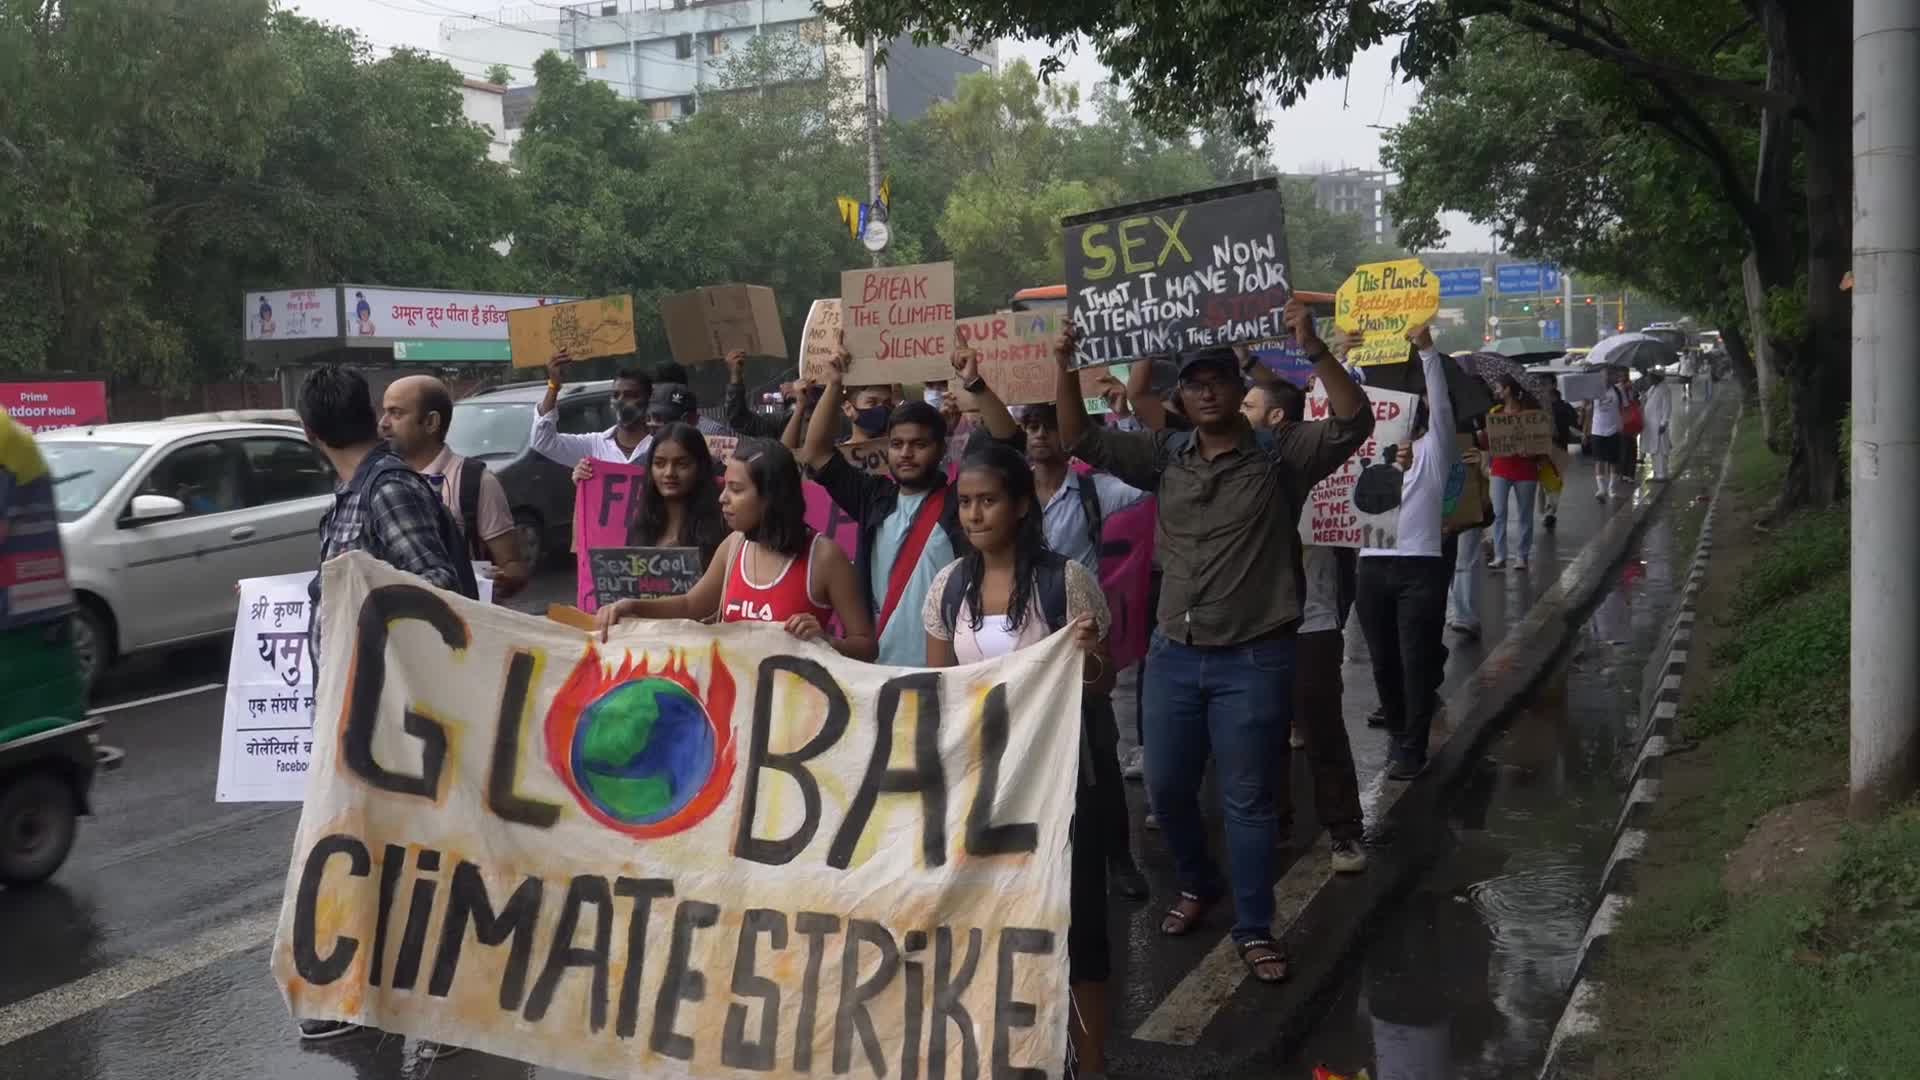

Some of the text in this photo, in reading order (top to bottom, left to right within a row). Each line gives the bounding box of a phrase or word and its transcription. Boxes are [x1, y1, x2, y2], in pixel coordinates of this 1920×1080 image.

[1081, 209, 1192, 280] SEX
[1212, 234, 1275, 268] NOW
[863, 274, 928, 304] BREAK
[1079, 263, 1289, 310] THAT I HAVE YOUR
[1355, 271, 1379, 293] This
[391, 304, 423, 327] अमूल
[426, 307, 444, 328] दूध
[446, 303, 469, 323] पीता
[471, 304, 480, 326] है
[850, 303, 953, 327] THE CLIMATE
[1073, 293, 1201, 336] ATTENTION,
[1186, 327, 1213, 346] THE
[1217, 307, 1284, 342] PLANET
[958, 319, 1008, 341] OUR
[875, 329, 945, 360] SILENCE
[20, 392, 48, 401] Prime
[48, 406, 76, 416] Media
[1314, 501, 1350, 517] THE
[1312, 516, 1357, 530] WORLD
[597, 577, 638, 593] BUT
[726, 600, 773, 620] FILA
[257, 632, 308, 687] यमु
[276, 760, 309, 773] Facebo
